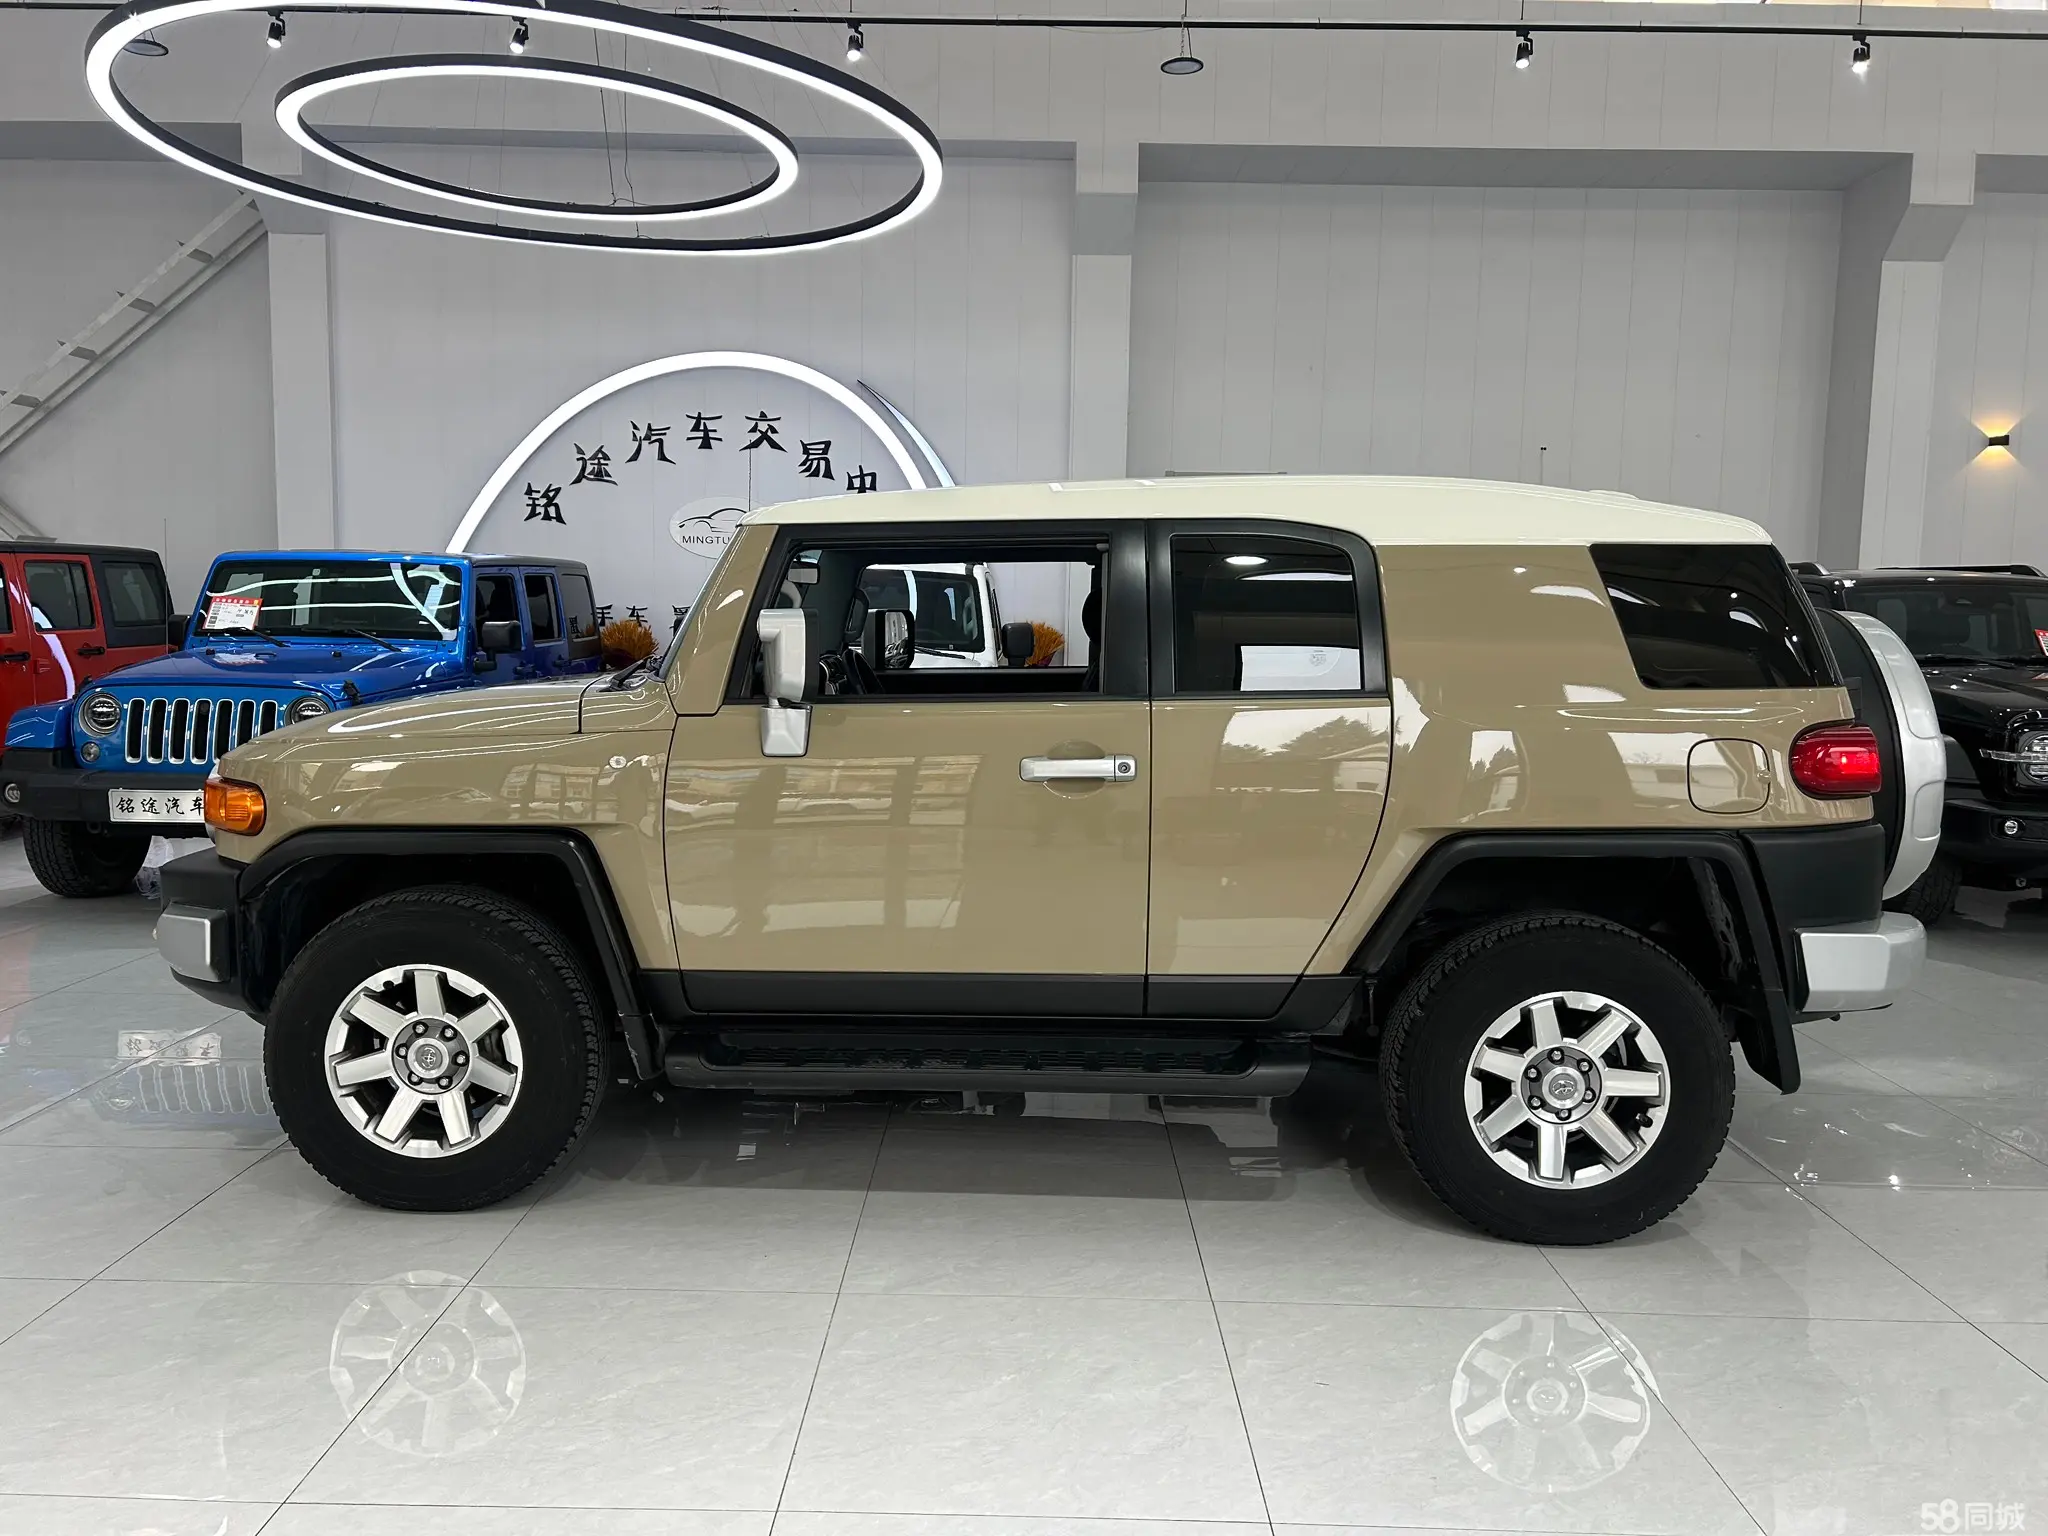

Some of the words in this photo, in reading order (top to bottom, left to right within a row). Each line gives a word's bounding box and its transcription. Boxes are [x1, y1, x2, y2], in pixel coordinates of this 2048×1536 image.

[524, 411, 877, 525] 铭途汽车交易中
[116, 797, 205, 816] 铭途汽车
